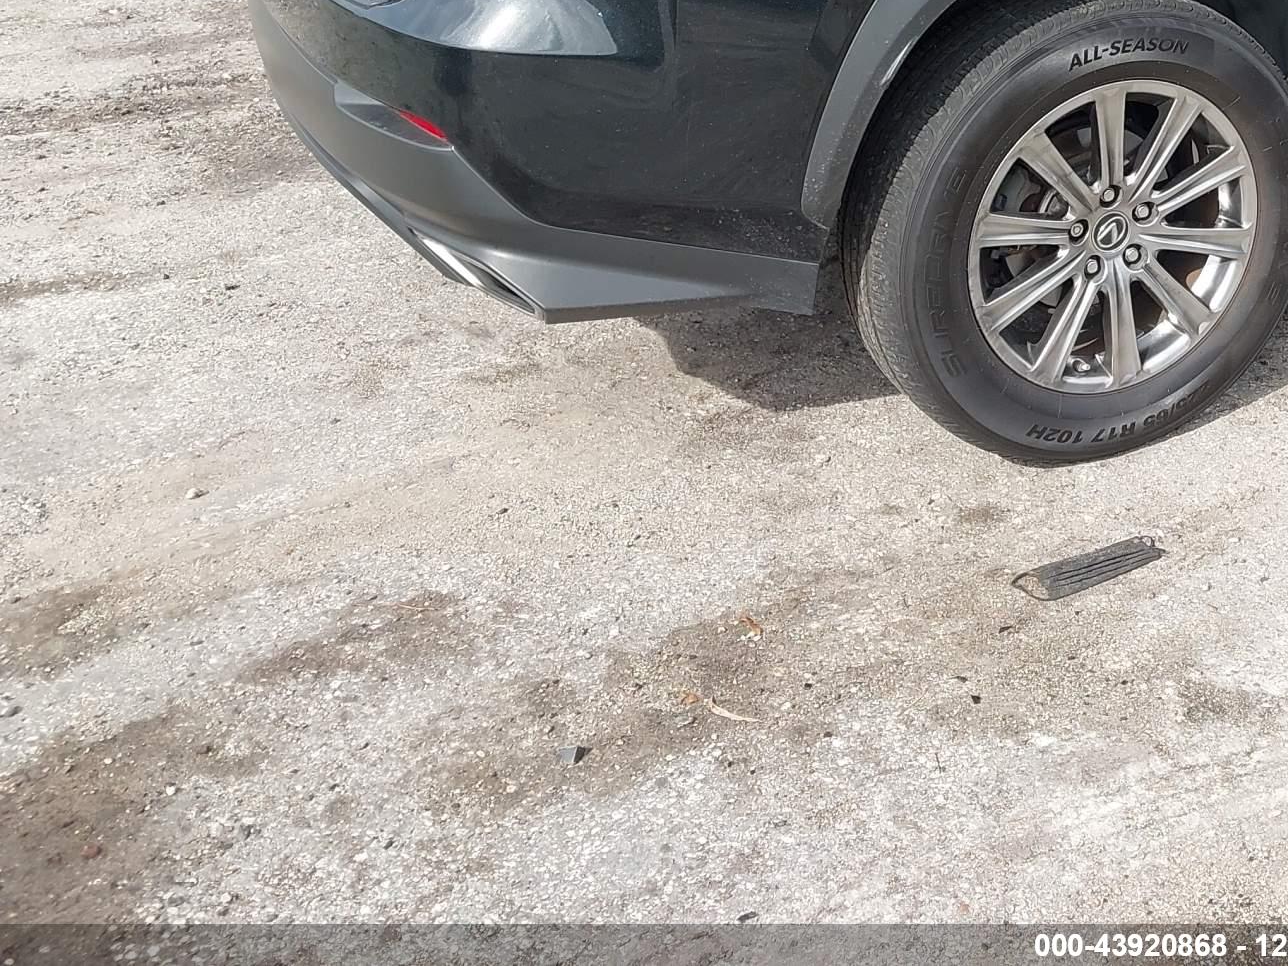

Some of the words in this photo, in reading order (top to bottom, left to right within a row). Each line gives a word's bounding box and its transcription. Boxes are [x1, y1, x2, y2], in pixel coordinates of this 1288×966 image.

[1068, 37, 1190, 72] ALL-SEASON
[1024, 422, 1083, 444] 102H
[1090, 421, 1137, 443] R17
